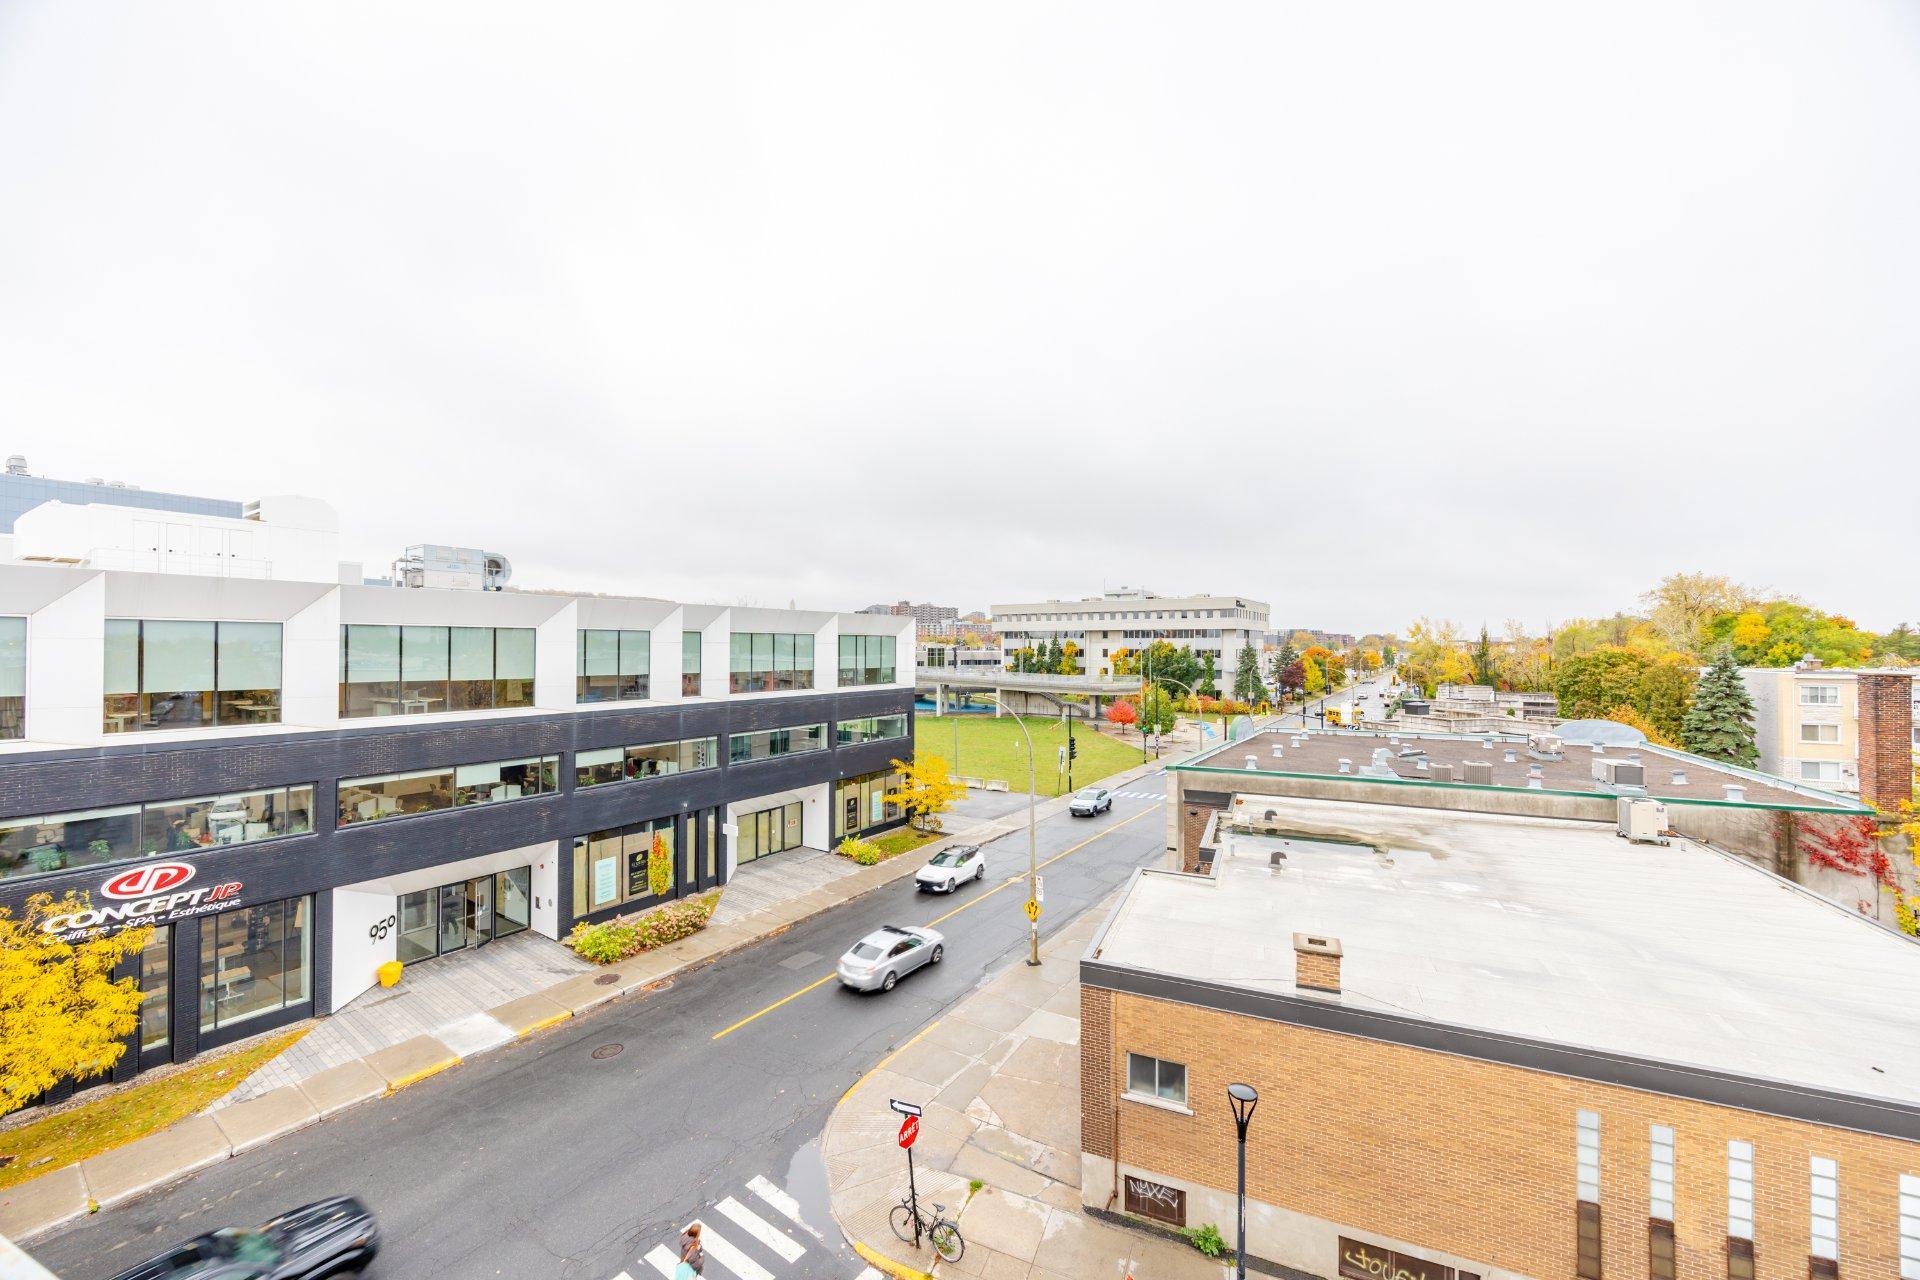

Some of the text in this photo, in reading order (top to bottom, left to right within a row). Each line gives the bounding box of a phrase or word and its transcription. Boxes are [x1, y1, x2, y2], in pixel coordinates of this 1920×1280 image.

[44, 881, 243, 933] CONCEPT JP
[125, 915, 156, 928] SPA
[168, 898, 242, 919] Esthétique
[370, 915, 396, 945] 950
[899, 1120, 920, 1143] ARRÊT
